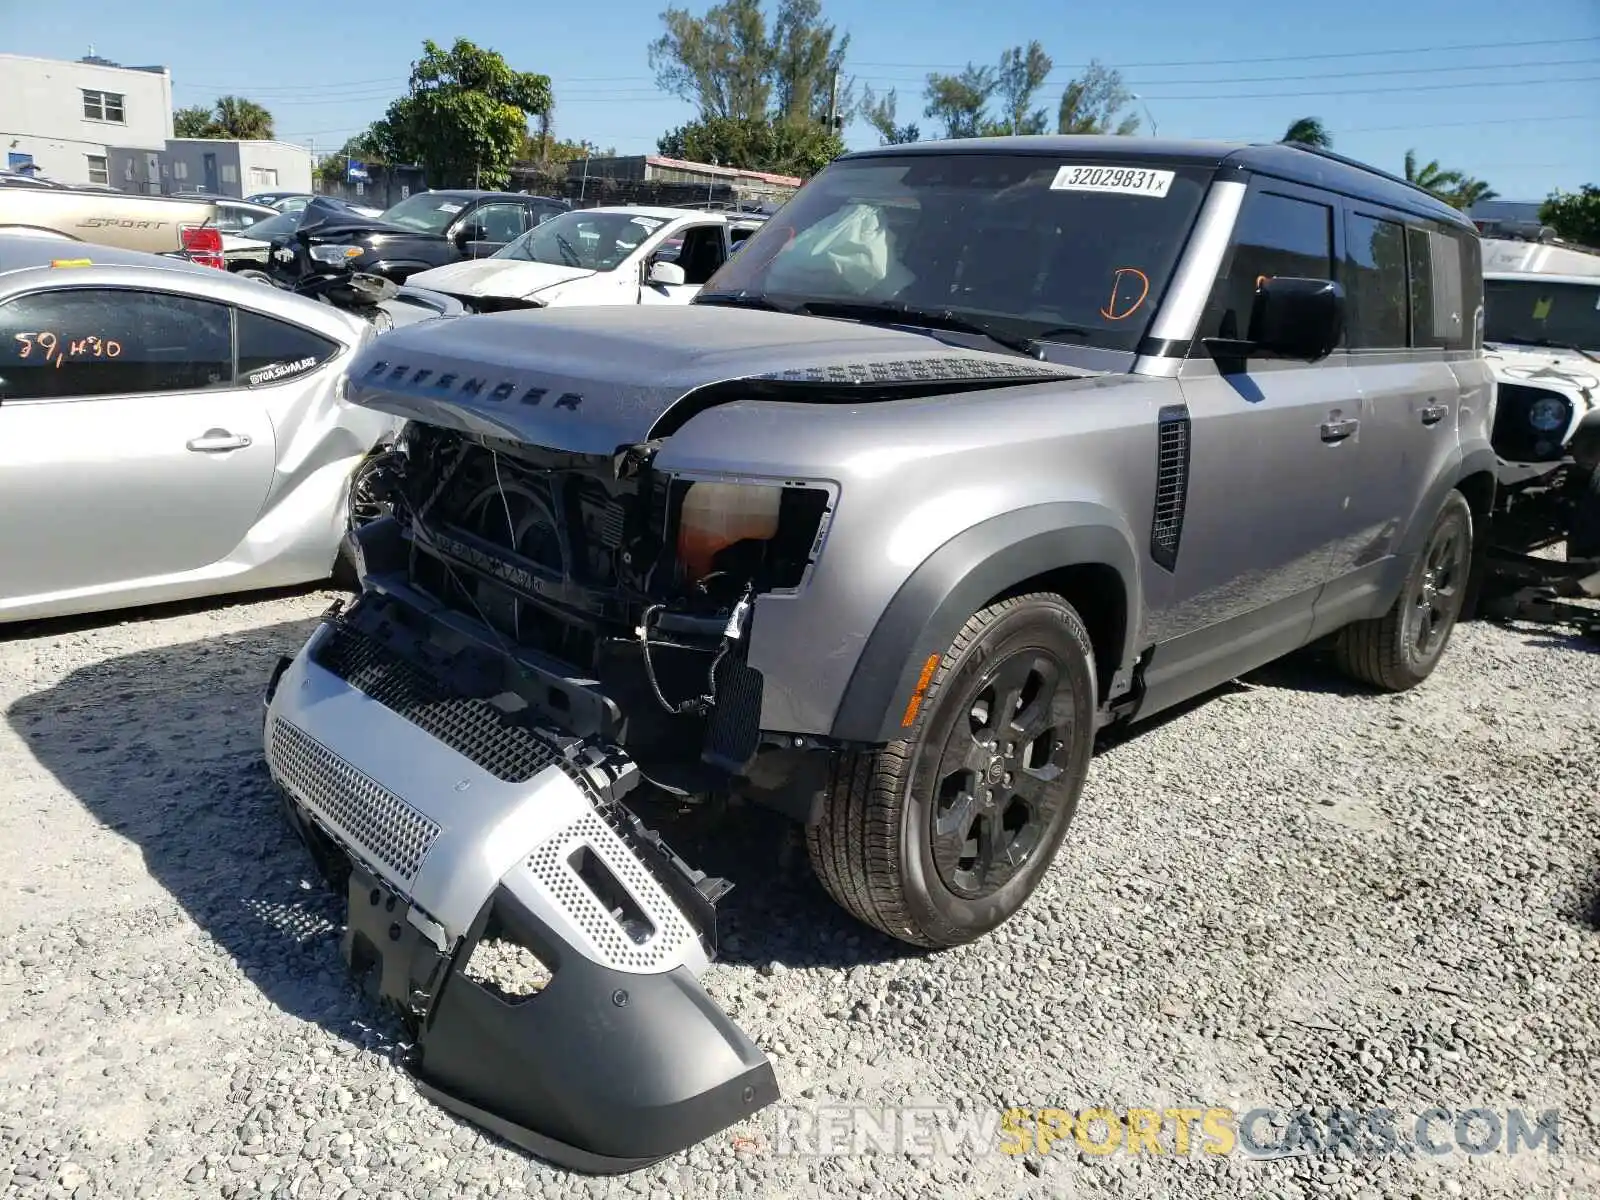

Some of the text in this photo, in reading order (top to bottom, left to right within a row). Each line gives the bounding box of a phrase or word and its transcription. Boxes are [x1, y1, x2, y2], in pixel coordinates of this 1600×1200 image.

[76, 217, 169, 230] SPORT
[1100, 267, 1149, 320] D
[362, 360, 584, 411] DEFENDER
